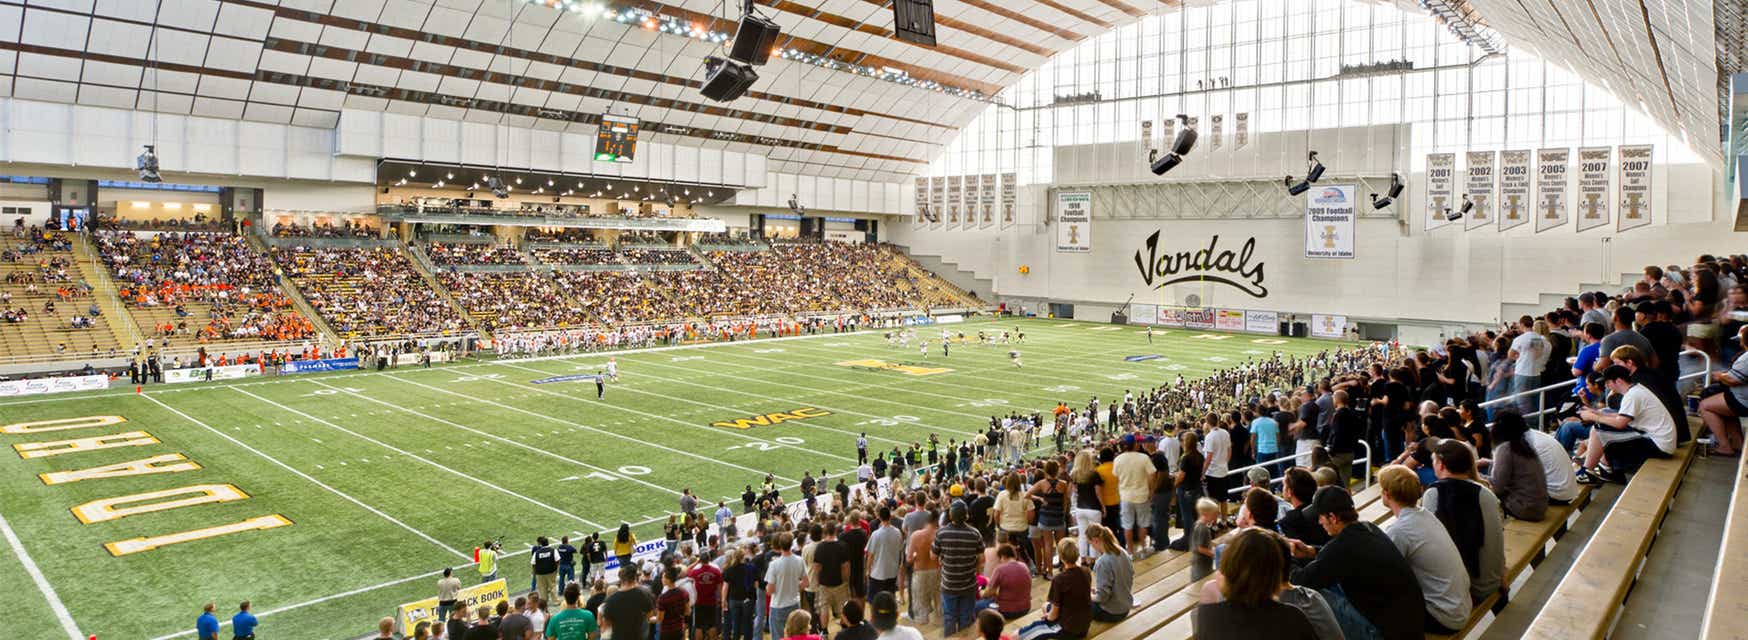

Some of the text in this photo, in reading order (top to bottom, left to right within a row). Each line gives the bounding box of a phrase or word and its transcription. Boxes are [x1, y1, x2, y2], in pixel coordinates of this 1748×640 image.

[1503, 166, 1527, 175] 2003
[1541, 164, 1566, 174] 2005
[1582, 162, 1607, 172] 2007
[1622, 161, 1649, 171] 2007
[1430, 169, 1450, 177] 2001
[1470, 167, 1491, 176] 2002
[1327, 207, 1353, 215] Football
[1312, 215, 1349, 223] Champions
[1134, 229, 1267, 292] Vandals
[708, 407, 834, 430] WAC
[744, 436, 805, 452] 20
[583, 465, 652, 481] 10
[636, 540, 665, 554] ORK
[480, 590, 504, 604] BOOK
